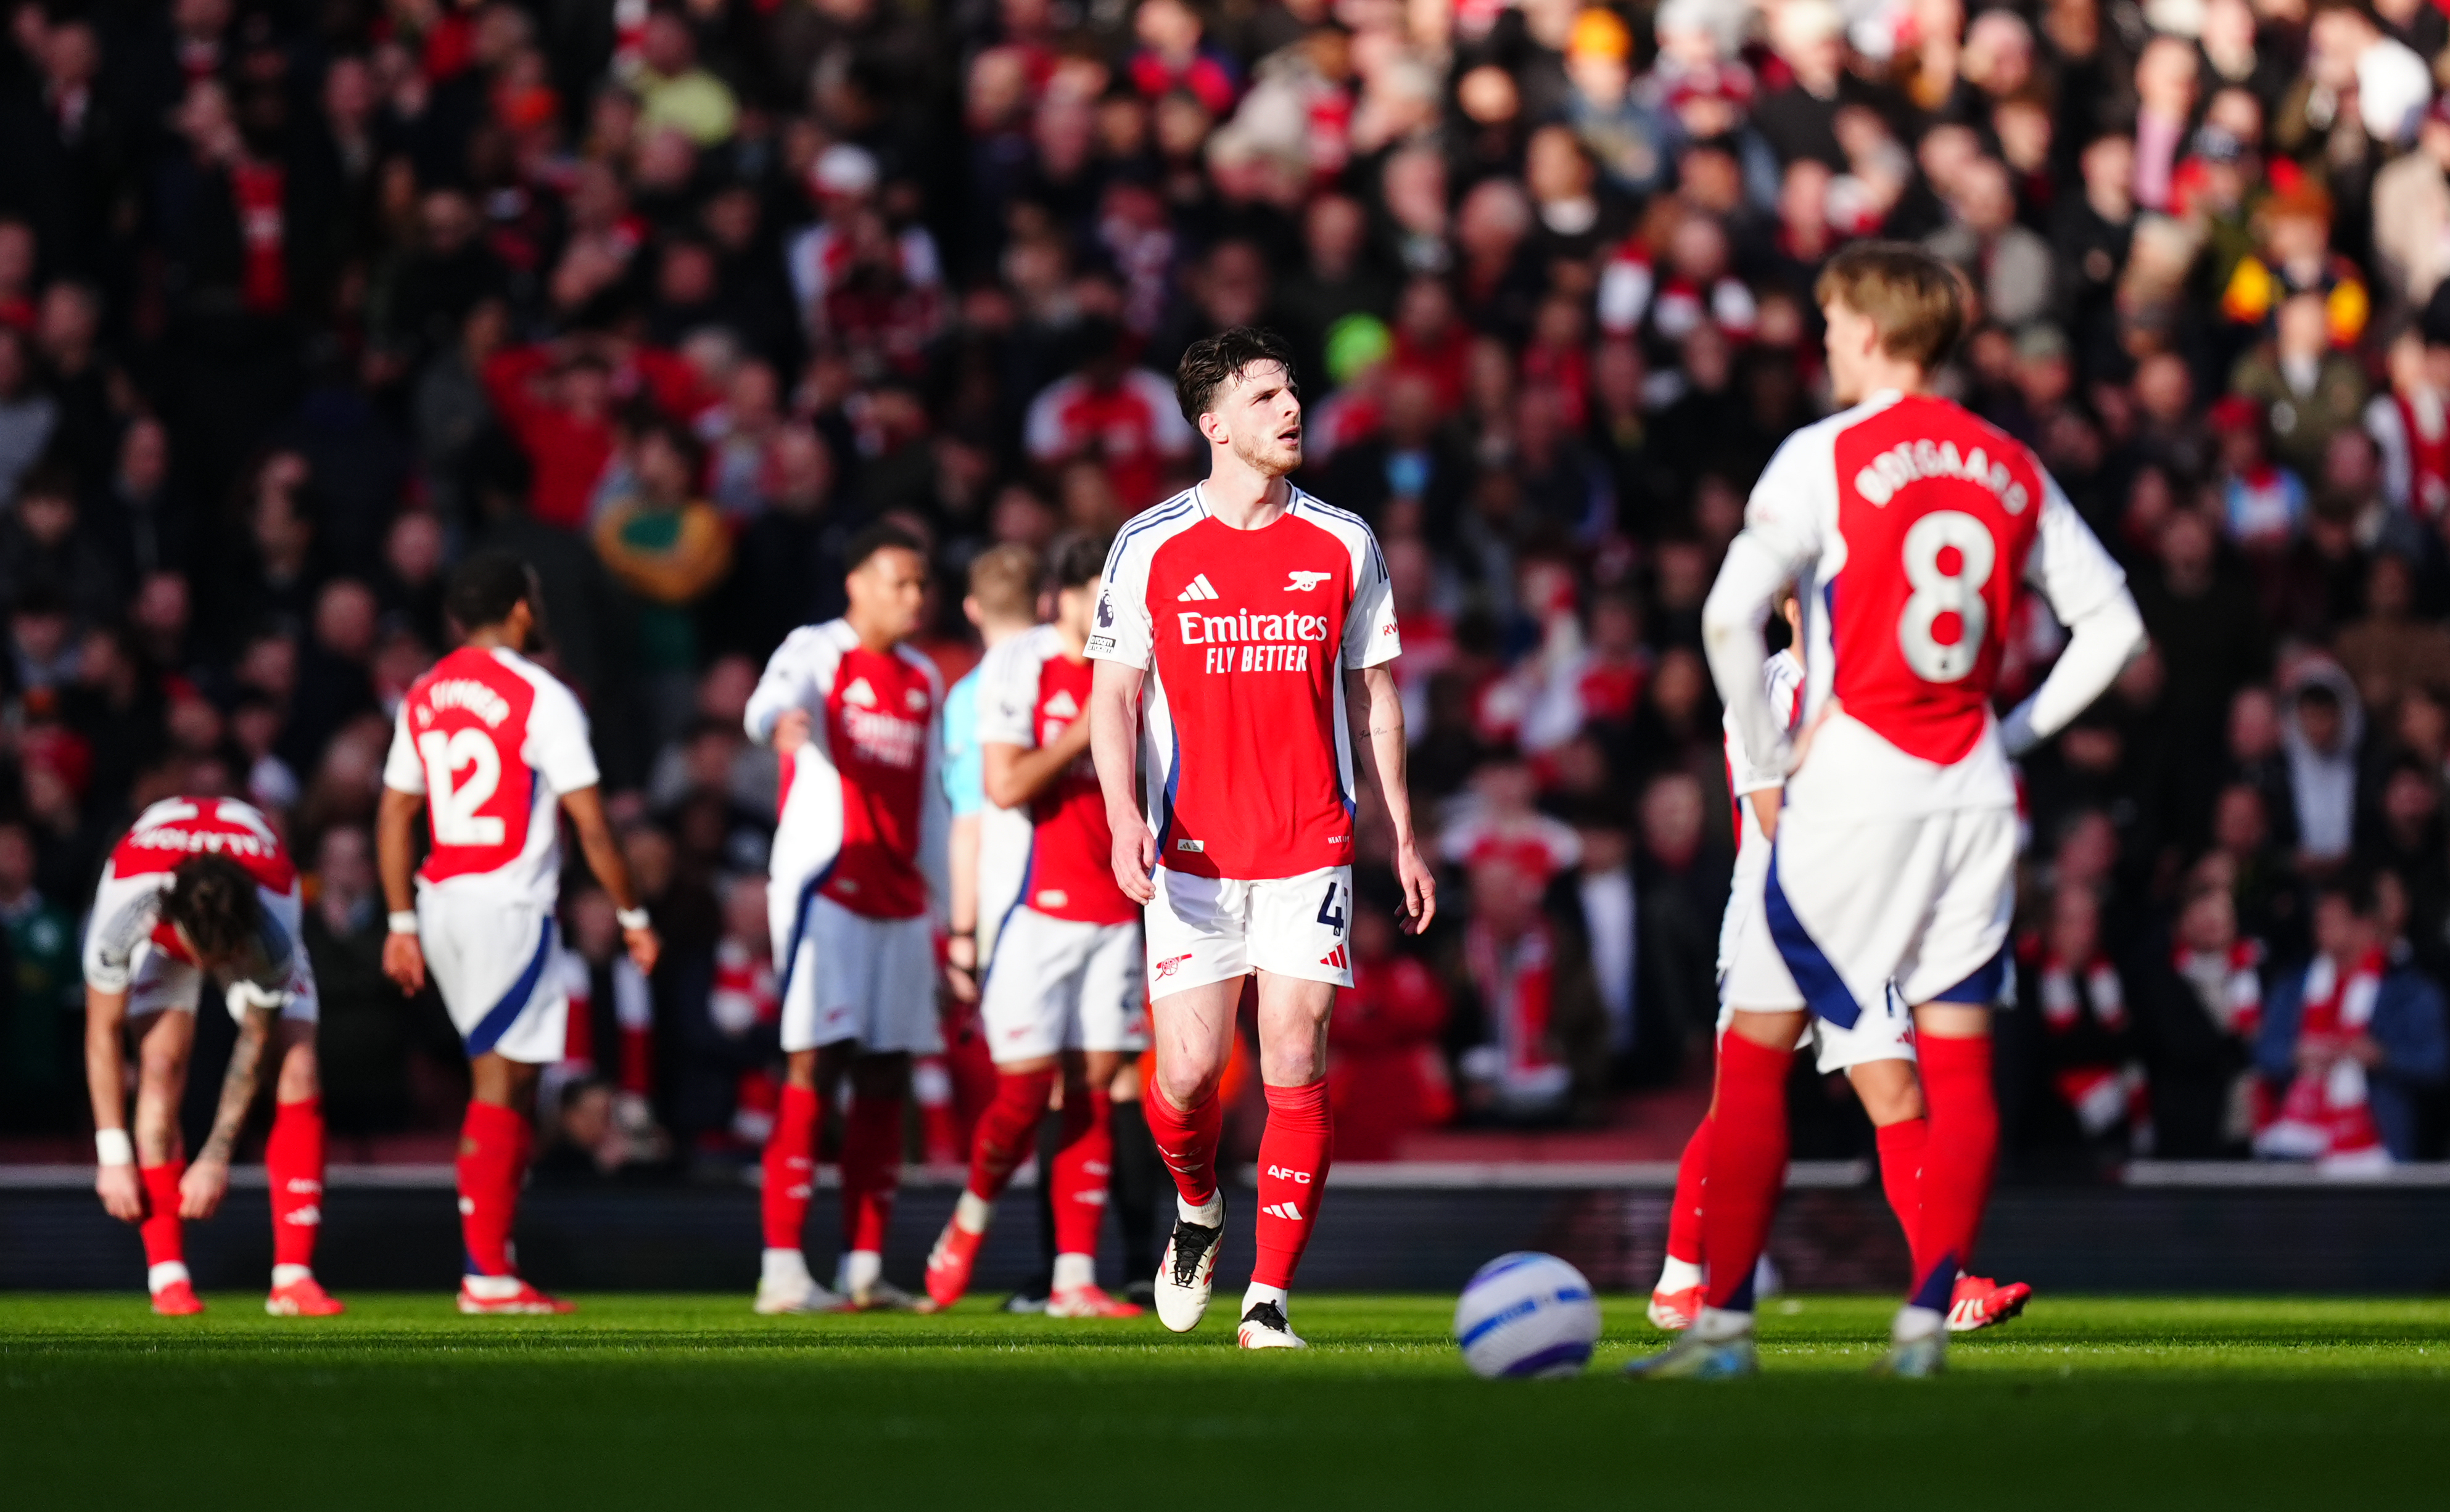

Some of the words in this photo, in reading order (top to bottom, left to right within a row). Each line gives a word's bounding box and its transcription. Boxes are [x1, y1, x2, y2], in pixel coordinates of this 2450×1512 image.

[1900, 510, 1995, 683] 8
[1178, 607, 1327, 644] Emirates
[1206, 647, 1235, 673] FLY
[1241, 645, 1308, 672] BETTER
[418, 727, 506, 845] 12
[1317, 882, 1344, 937] 4
[1267, 1165, 1311, 1184] AFC
